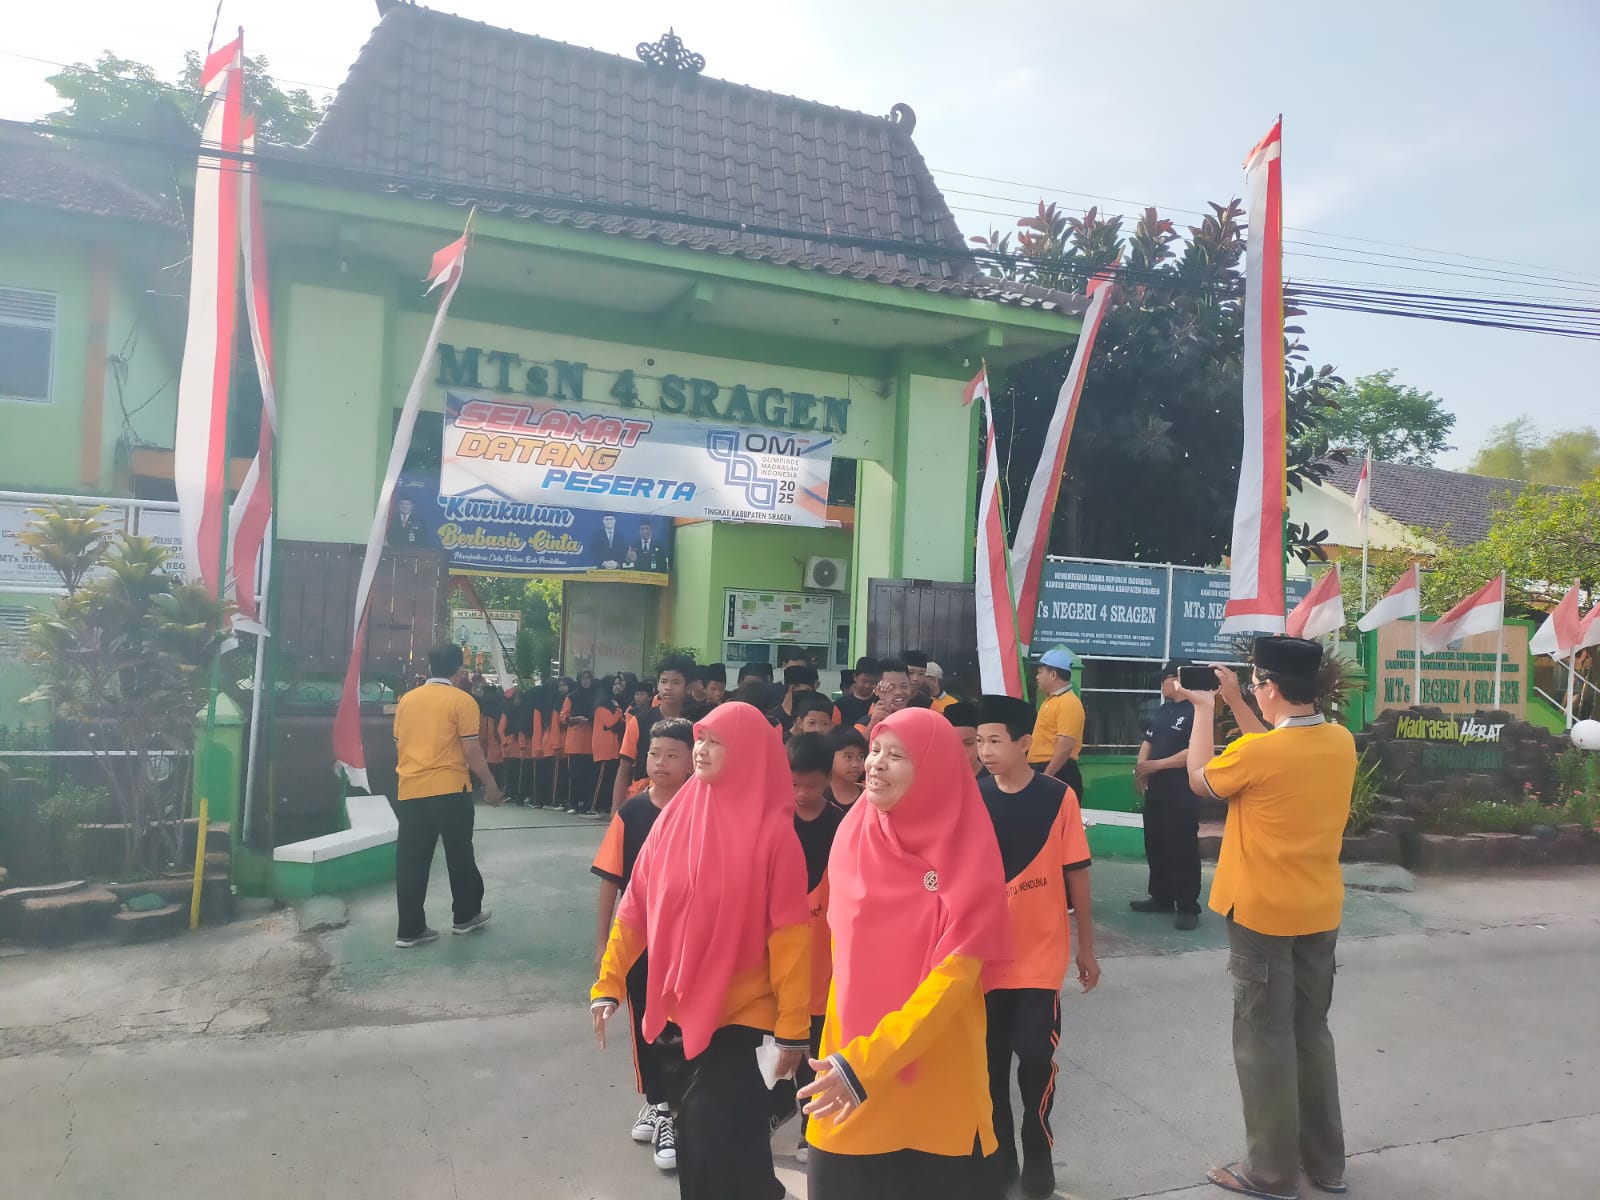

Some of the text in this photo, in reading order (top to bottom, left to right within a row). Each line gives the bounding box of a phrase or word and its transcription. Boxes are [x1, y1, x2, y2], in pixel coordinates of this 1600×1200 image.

[436, 343, 851, 434] MTsN 4 SRAGEN
[453, 399, 653, 448] SELAMAT
[456, 432, 621, 471] DATANG
[761, 456, 799, 466] OLIMPIADE
[760, 470, 798, 478] INDONESIA
[761, 463, 799, 472] MADRASAH
[541, 468, 697, 502] PESERTA
[779, 480, 796, 491] 20
[777, 493, 794, 504] 25
[437, 496, 575, 528] Kurikulum
[703, 507, 792, 521] TINGKAT KABUPATEN SRAGEN
[437, 523, 583, 555] Berbasis Cinta
[1052, 601, 1097, 621] NEGERI
[1100, 604, 1107, 621] 4
[1110, 605, 1156, 624] SRAGEN
[1183, 601, 1223, 620] MTs NE
[1384, 677, 1411, 703] MTs
[1463, 679, 1471, 704] 4
[1396, 716, 1506, 744] Madrasah HEBAT
